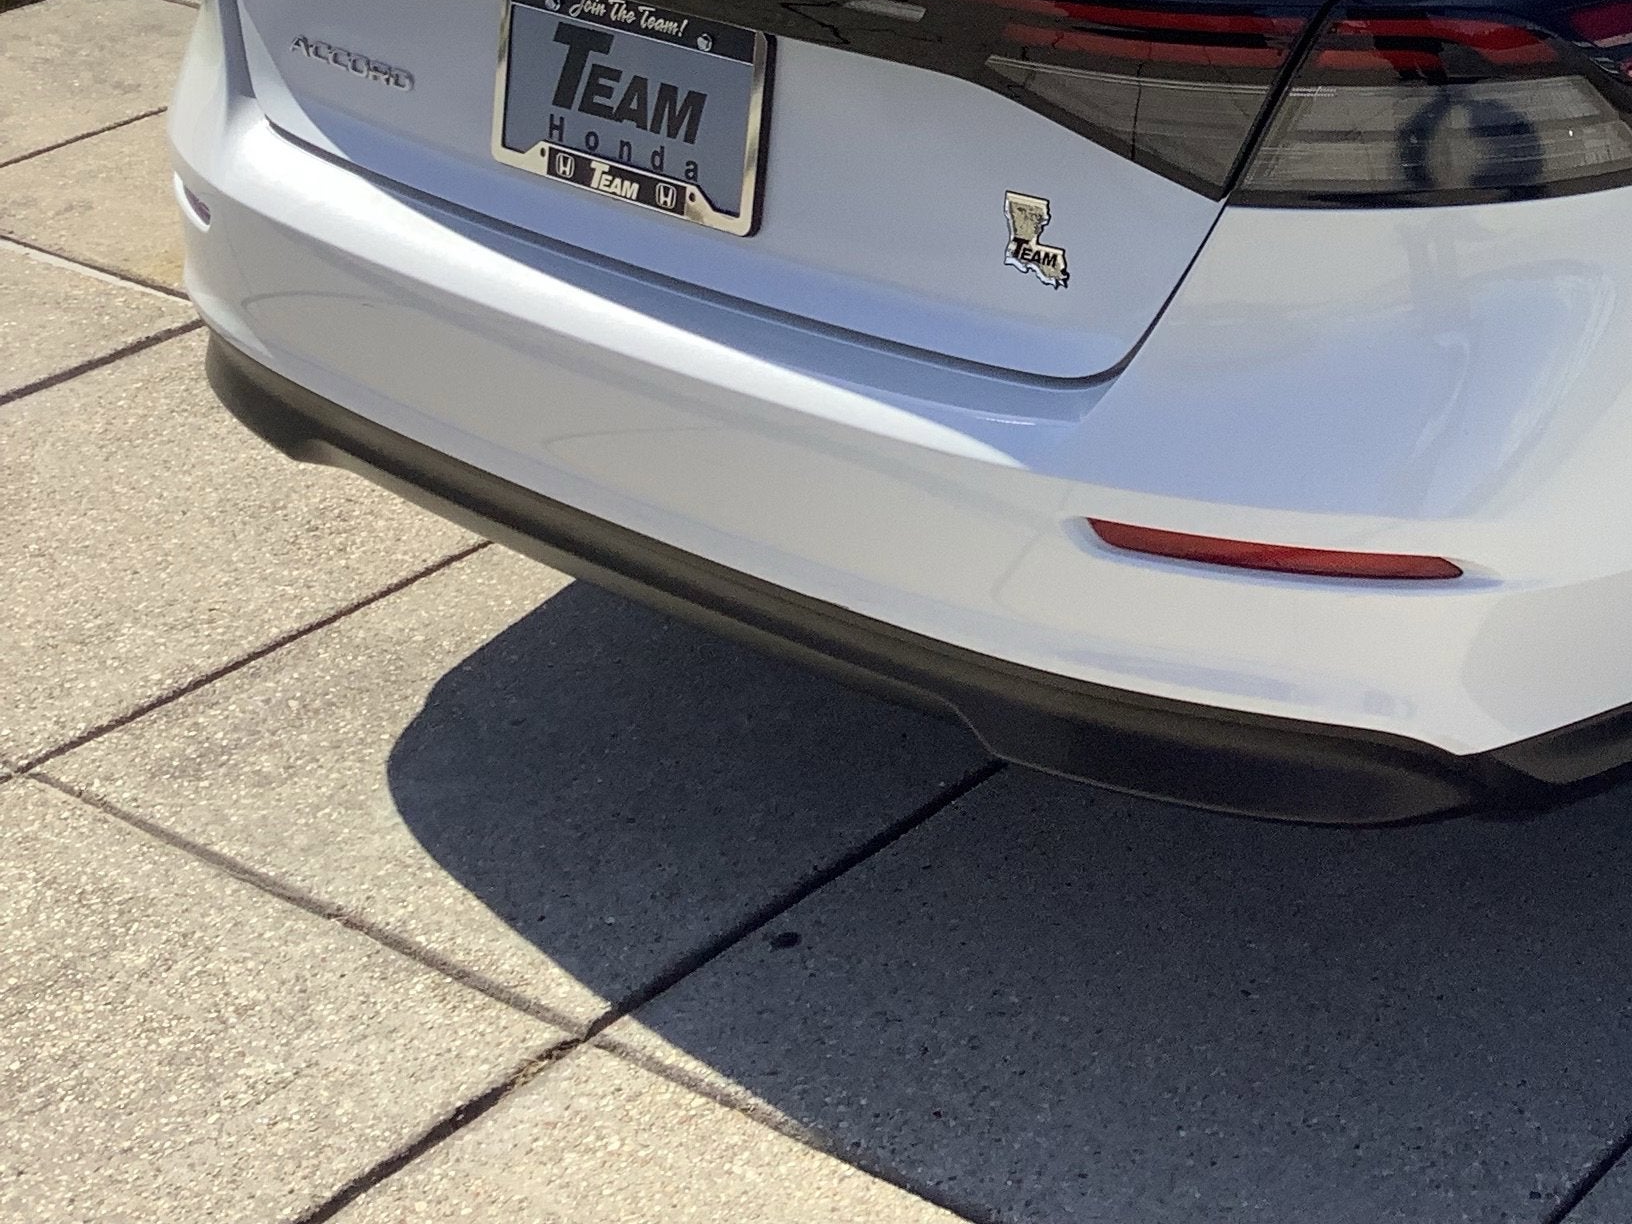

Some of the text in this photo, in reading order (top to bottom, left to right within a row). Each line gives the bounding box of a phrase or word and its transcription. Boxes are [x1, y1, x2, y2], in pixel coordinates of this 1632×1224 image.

[638, 5, 689, 37] Team!
[289, 34, 416, 92] ACCORD
[552, 21, 708, 145] TEAM
[549, 114, 699, 183] Honda
[589, 161, 640, 200] TEAM
[1012, 237, 1059, 267] TEAM
